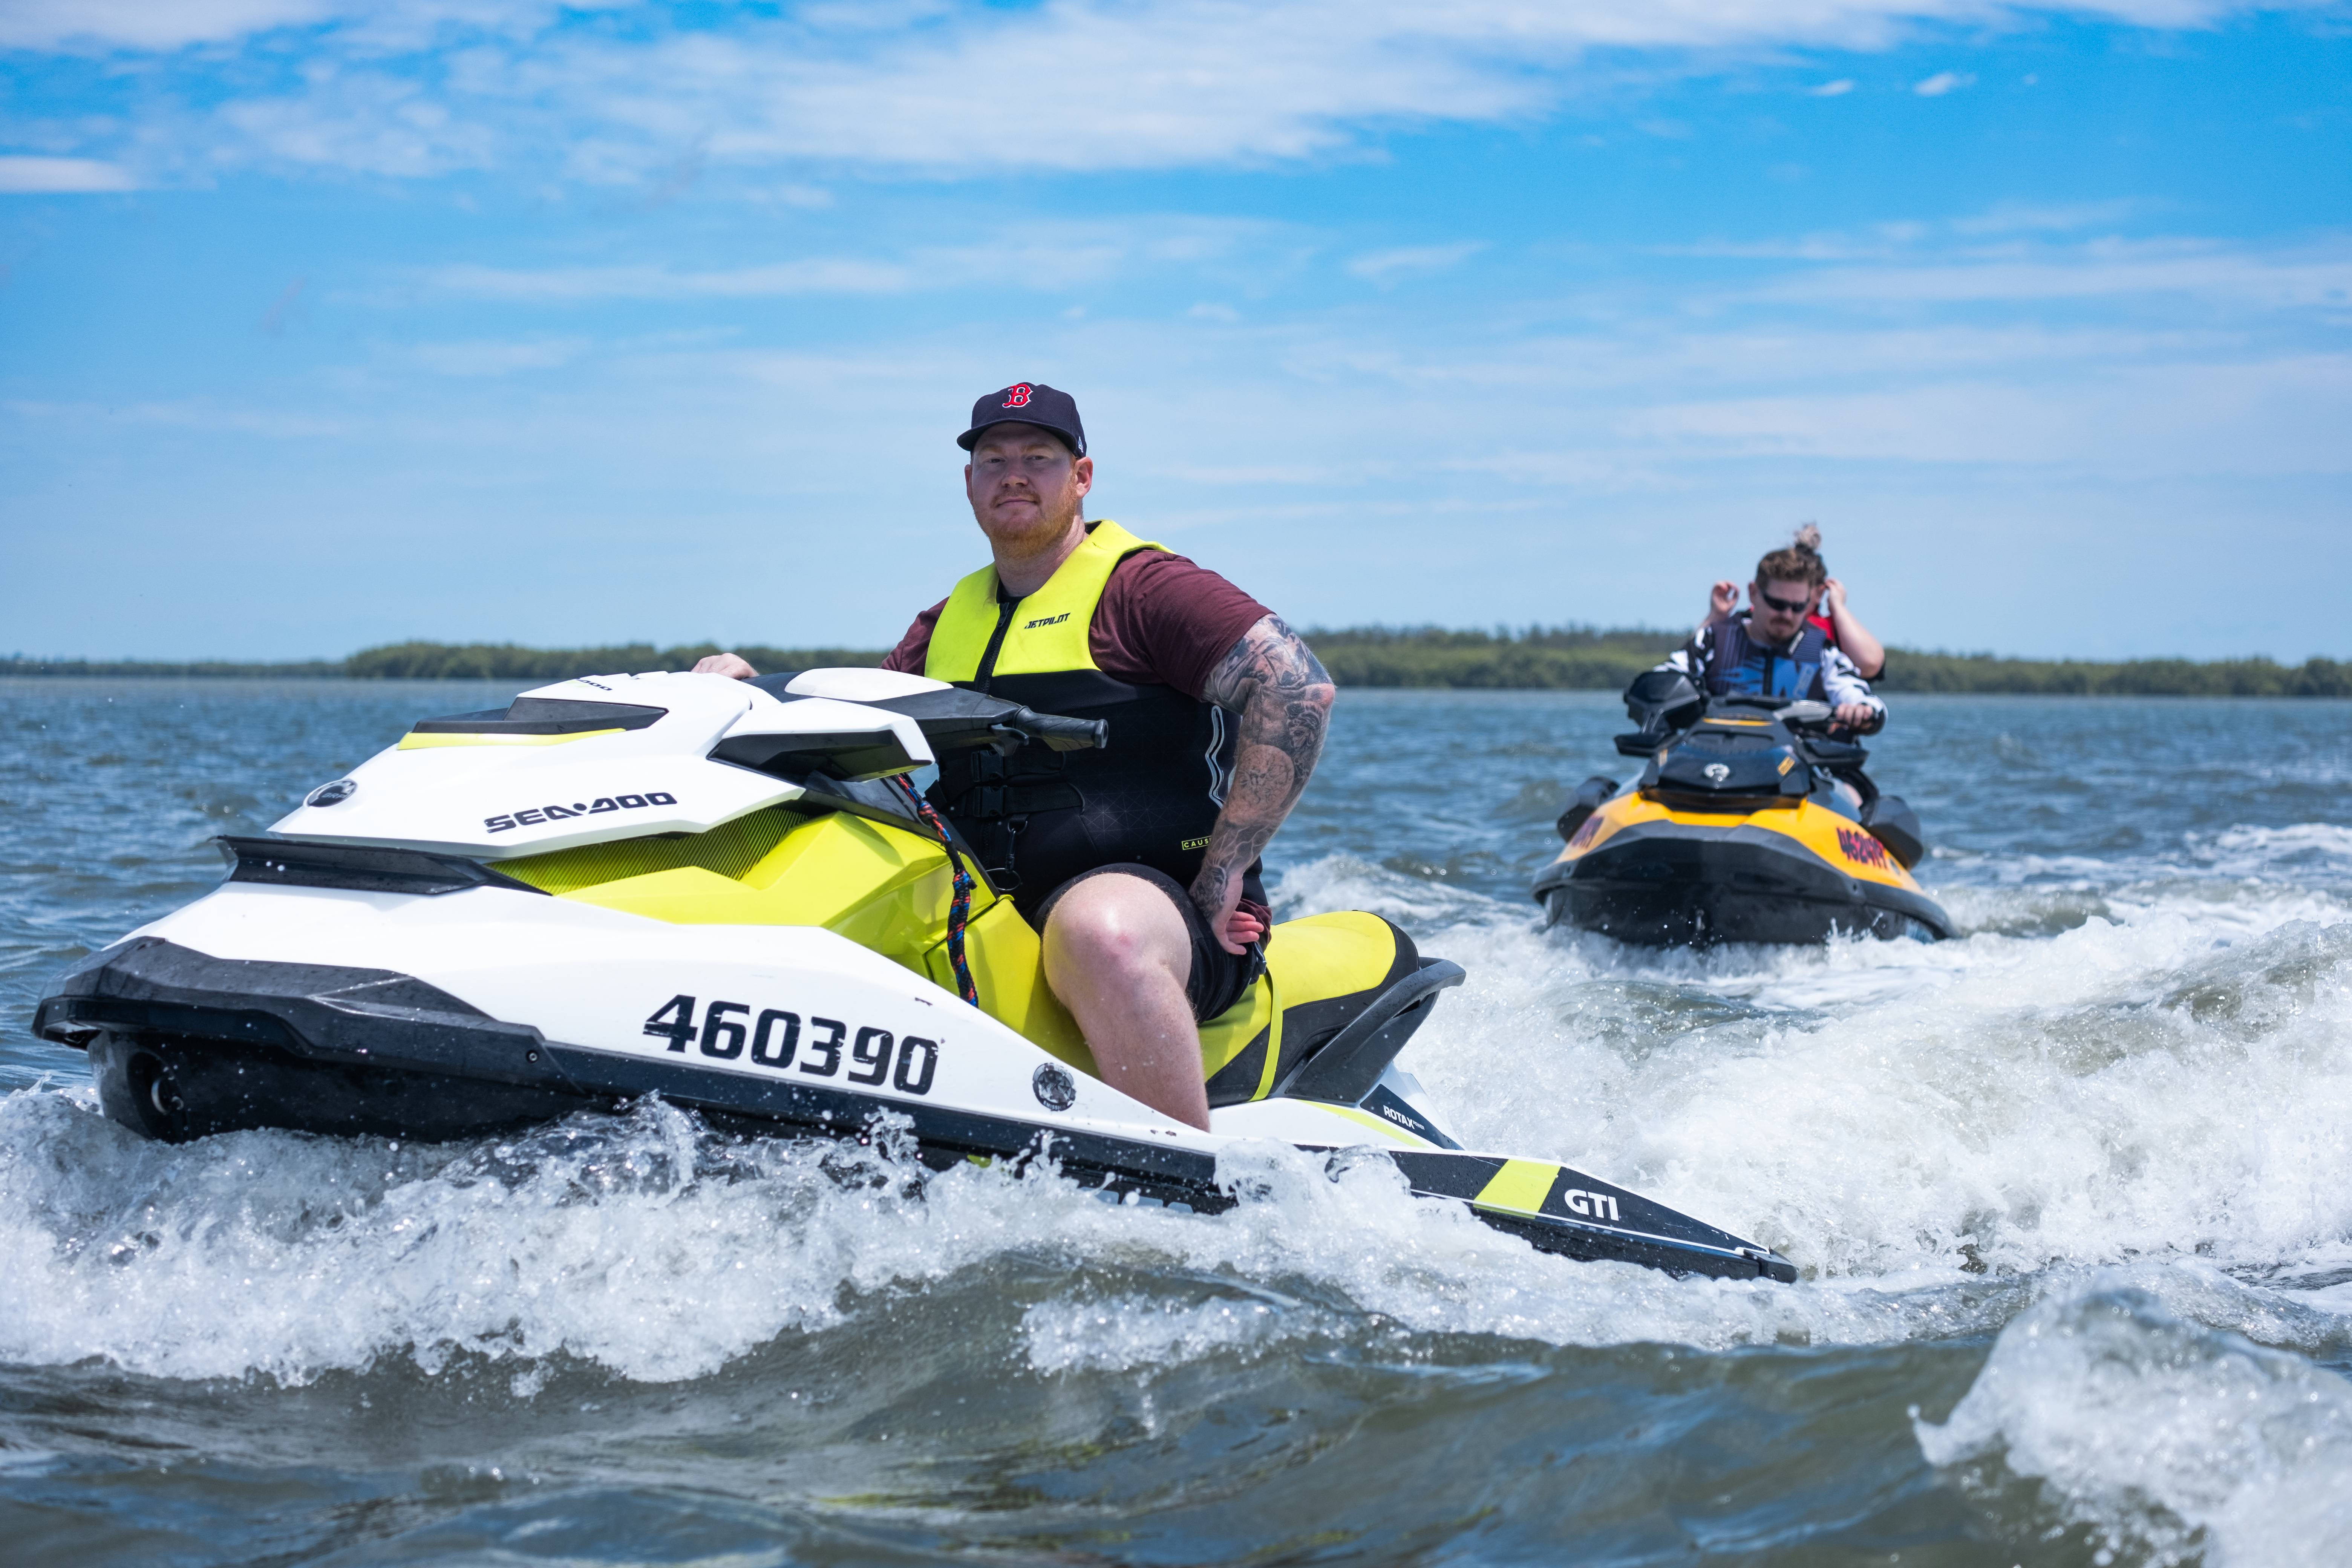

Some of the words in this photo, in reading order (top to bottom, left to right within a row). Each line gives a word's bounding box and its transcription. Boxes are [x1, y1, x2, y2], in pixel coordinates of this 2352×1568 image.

[1002, 384, 1034, 408] B
[1024, 612, 1071, 629] JETPILOT
[1184, 838, 1211, 848] CAUS
[642, 994, 939, 1095] 460390
[1383, 1105, 1415, 1130] ROTAX
[1413, 1120, 1425, 1130] POWER
[1564, 1189, 1619, 1221] GTI
